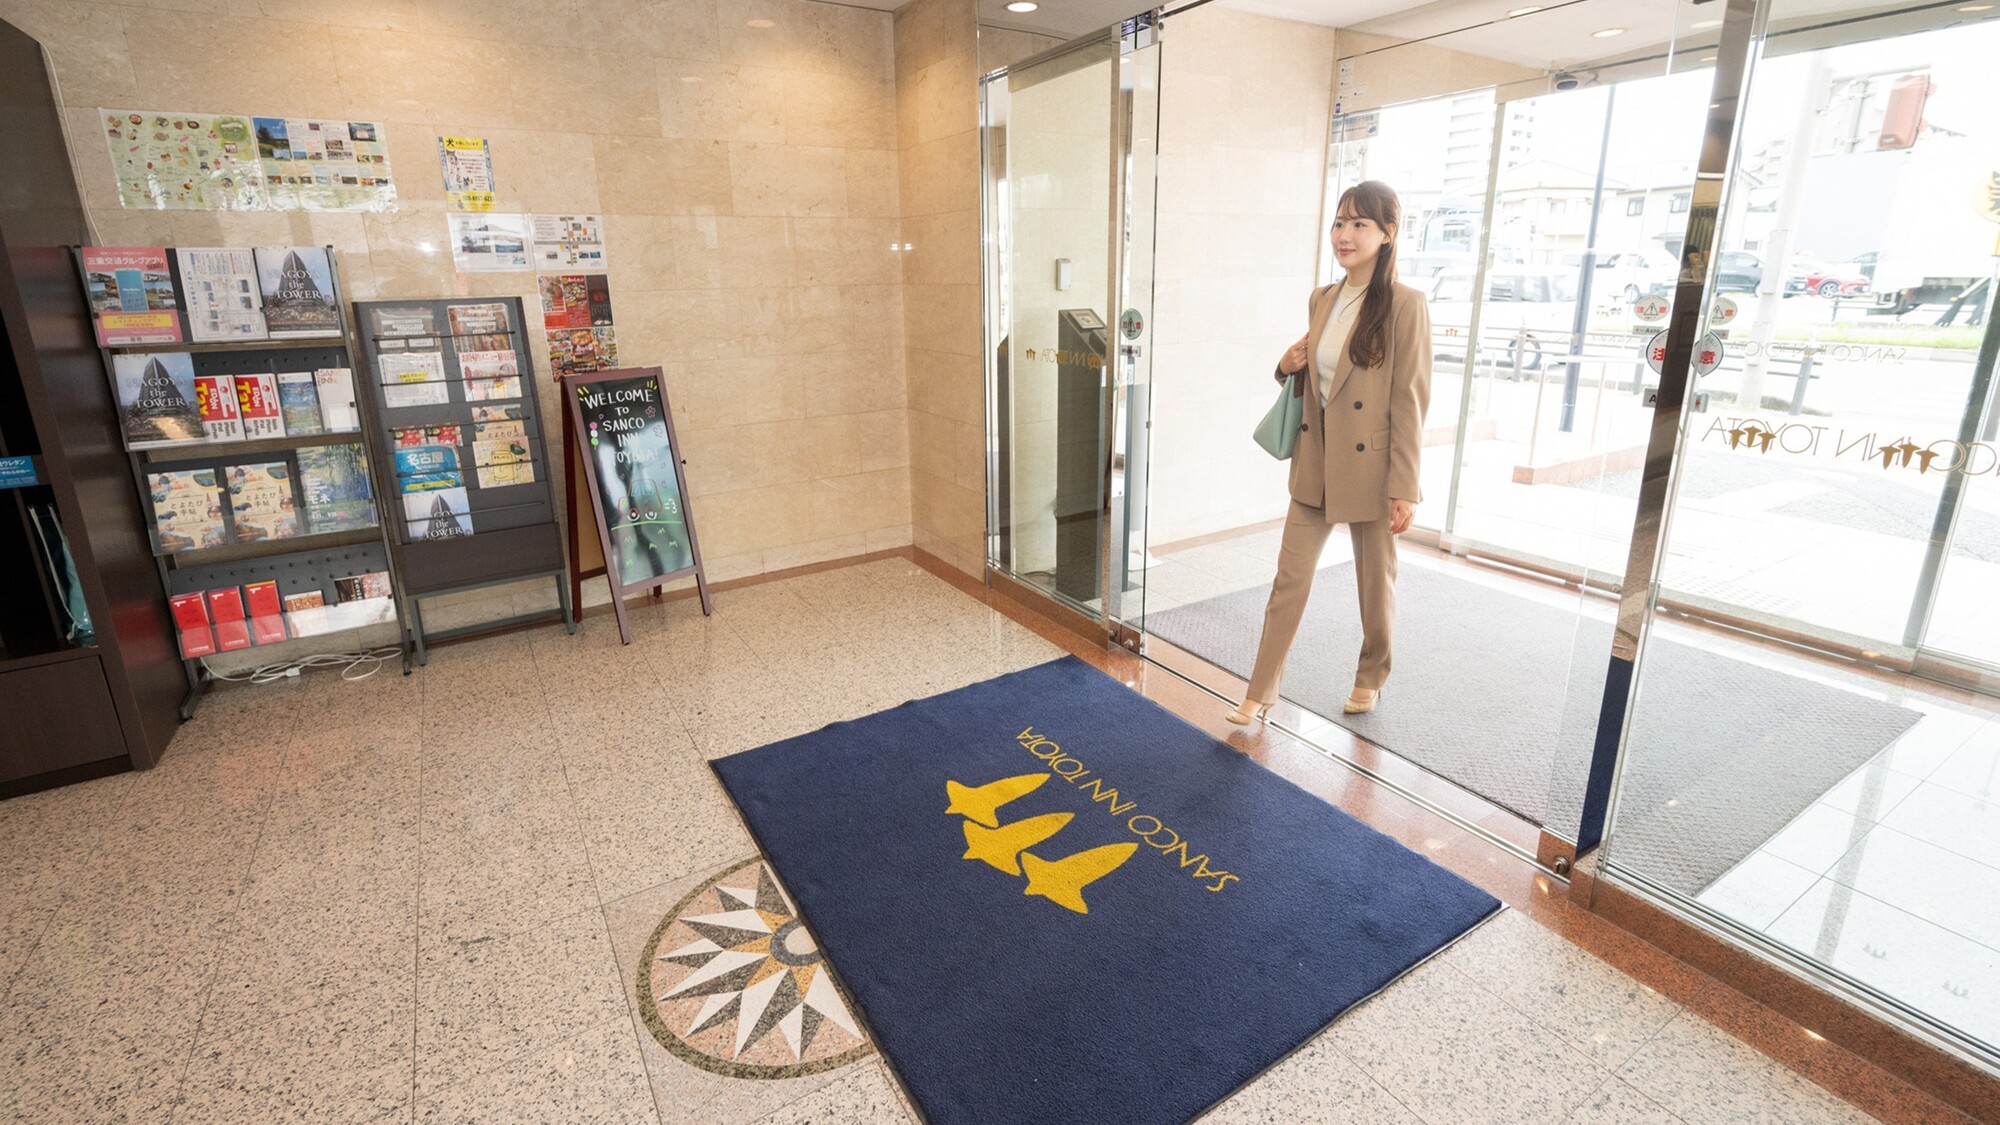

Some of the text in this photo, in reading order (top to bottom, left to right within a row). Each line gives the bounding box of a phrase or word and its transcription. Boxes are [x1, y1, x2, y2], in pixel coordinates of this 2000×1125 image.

[87, 256, 163, 265] 三重交通グループアプリ
[288, 279, 305, 290] the
[277, 289, 322, 299] TOWER
[149, 388, 167, 398] the
[136, 397, 187, 409] TOWER
[584, 389, 654, 410] WELCOME
[614, 406, 630, 416] TO
[602, 417, 645, 432] SANCO
[617, 431, 640, 448] INN
[406, 452, 444, 466] 名古屋
[246, 492, 276, 501] とよたび
[170, 500, 203, 509] とよたび
[435, 520, 449, 529] the
[425, 527, 463, 539] TOWER
[1015, 726, 1241, 893] SANCO INN TOYOTA
